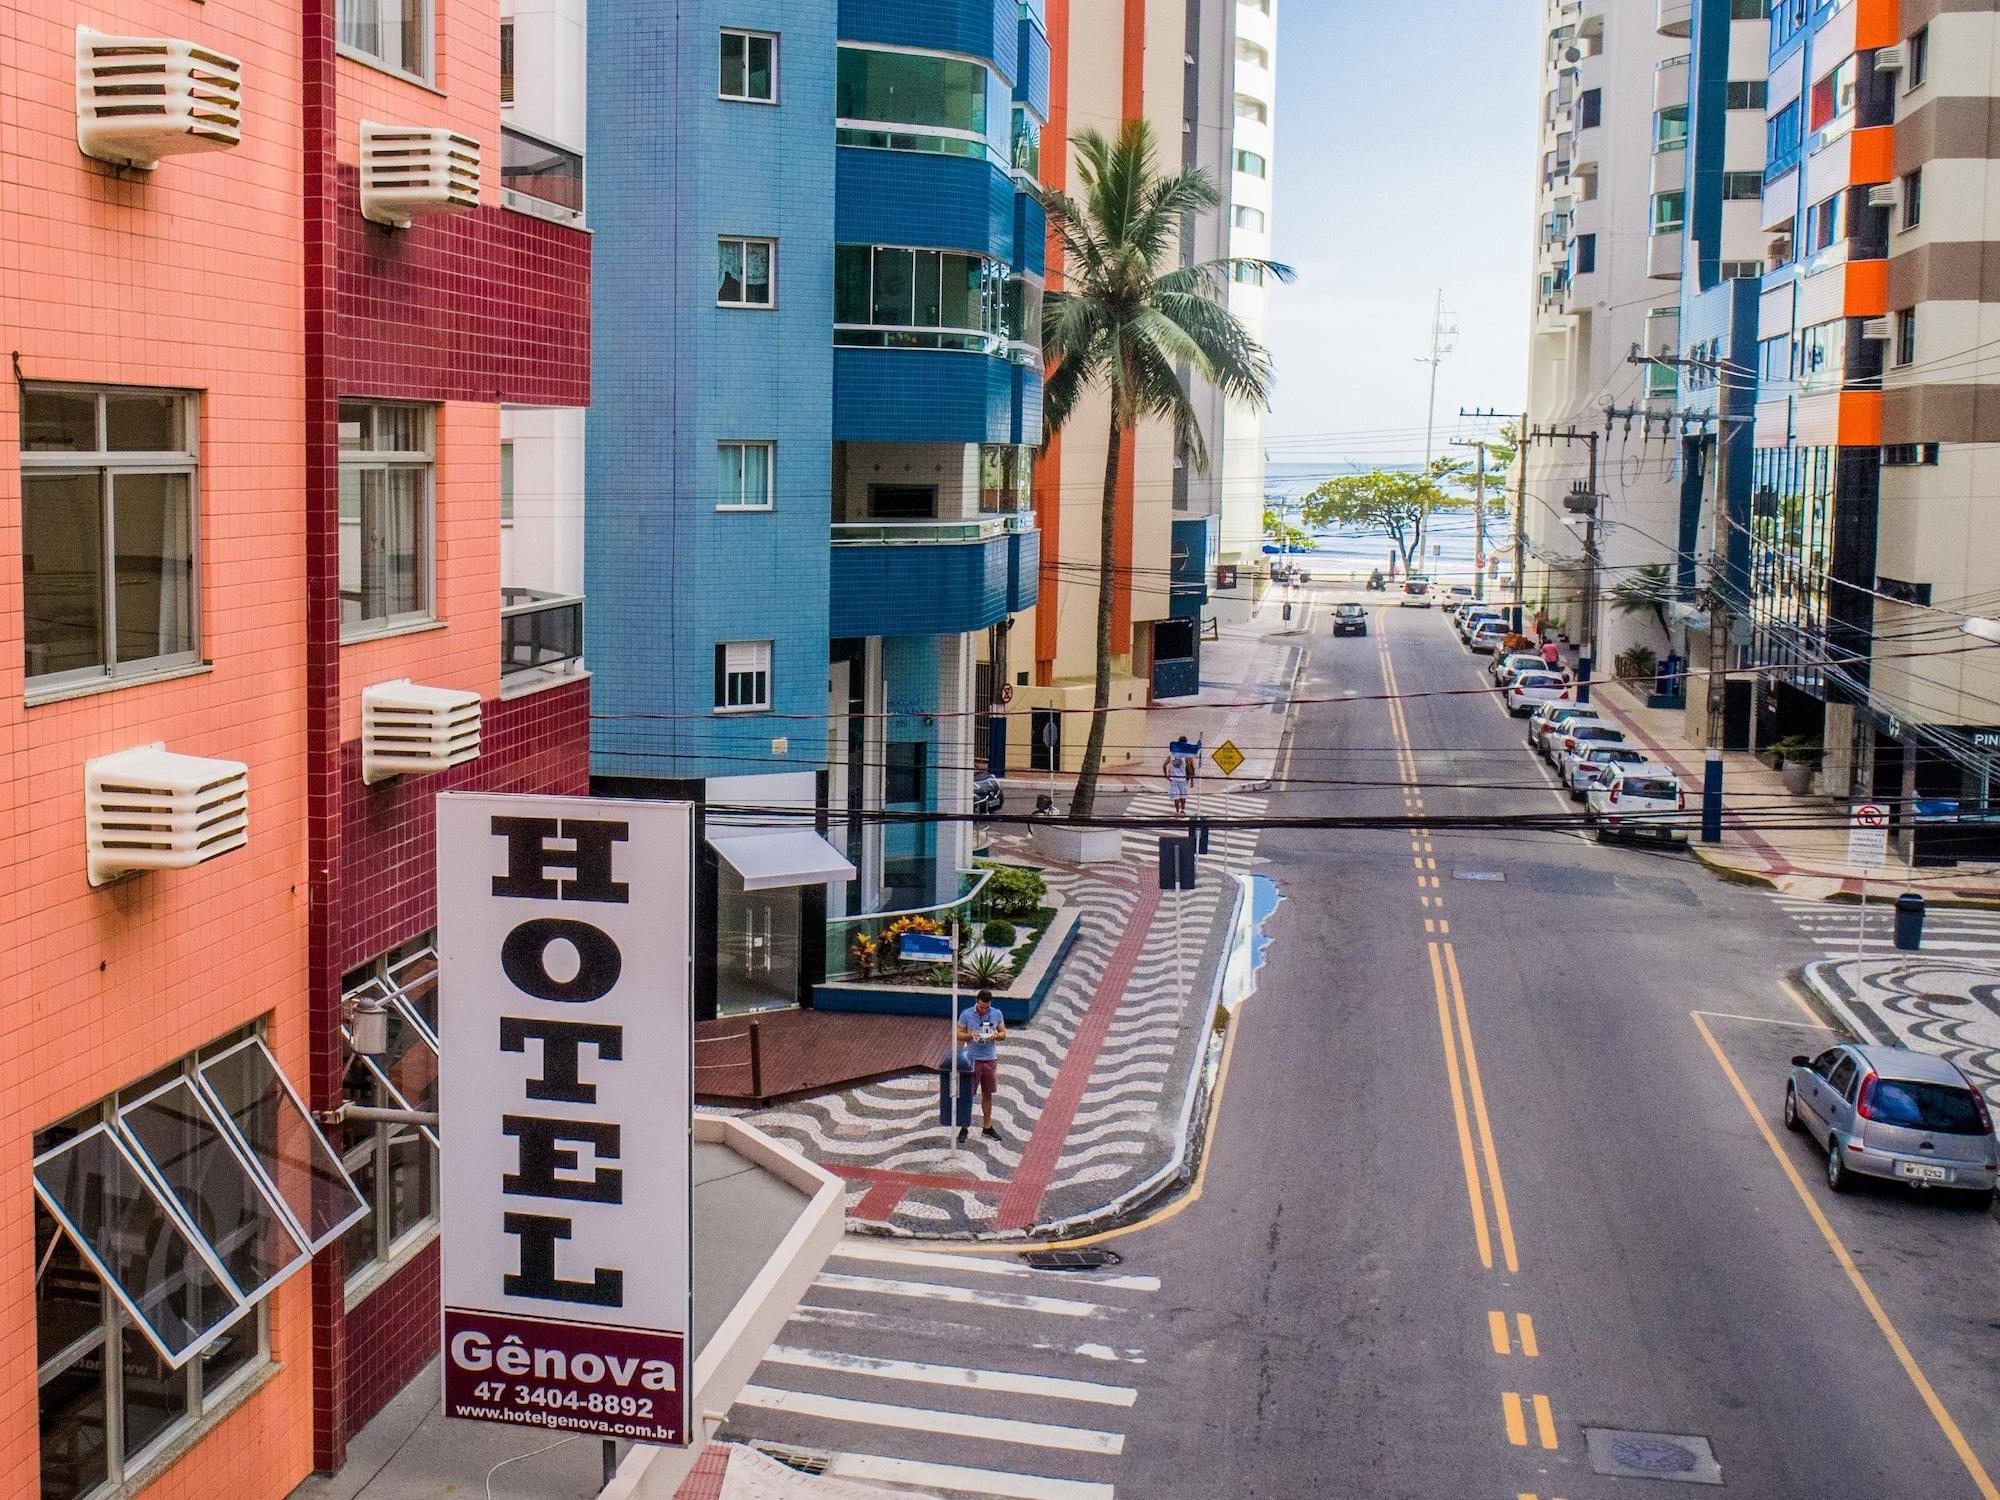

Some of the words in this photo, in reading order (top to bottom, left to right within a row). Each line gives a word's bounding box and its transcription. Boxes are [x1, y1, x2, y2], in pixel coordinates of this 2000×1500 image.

[1975, 734, 2000, 745] PIN
[491, 815, 629, 1308] HOTEL
[451, 1330, 677, 1392] Gênova
[474, 1381, 507, 1402] 47
[515, 1385, 654, 1419] 3404-8892
[456, 1404, 676, 1440] www.hotelgenova.com.br
